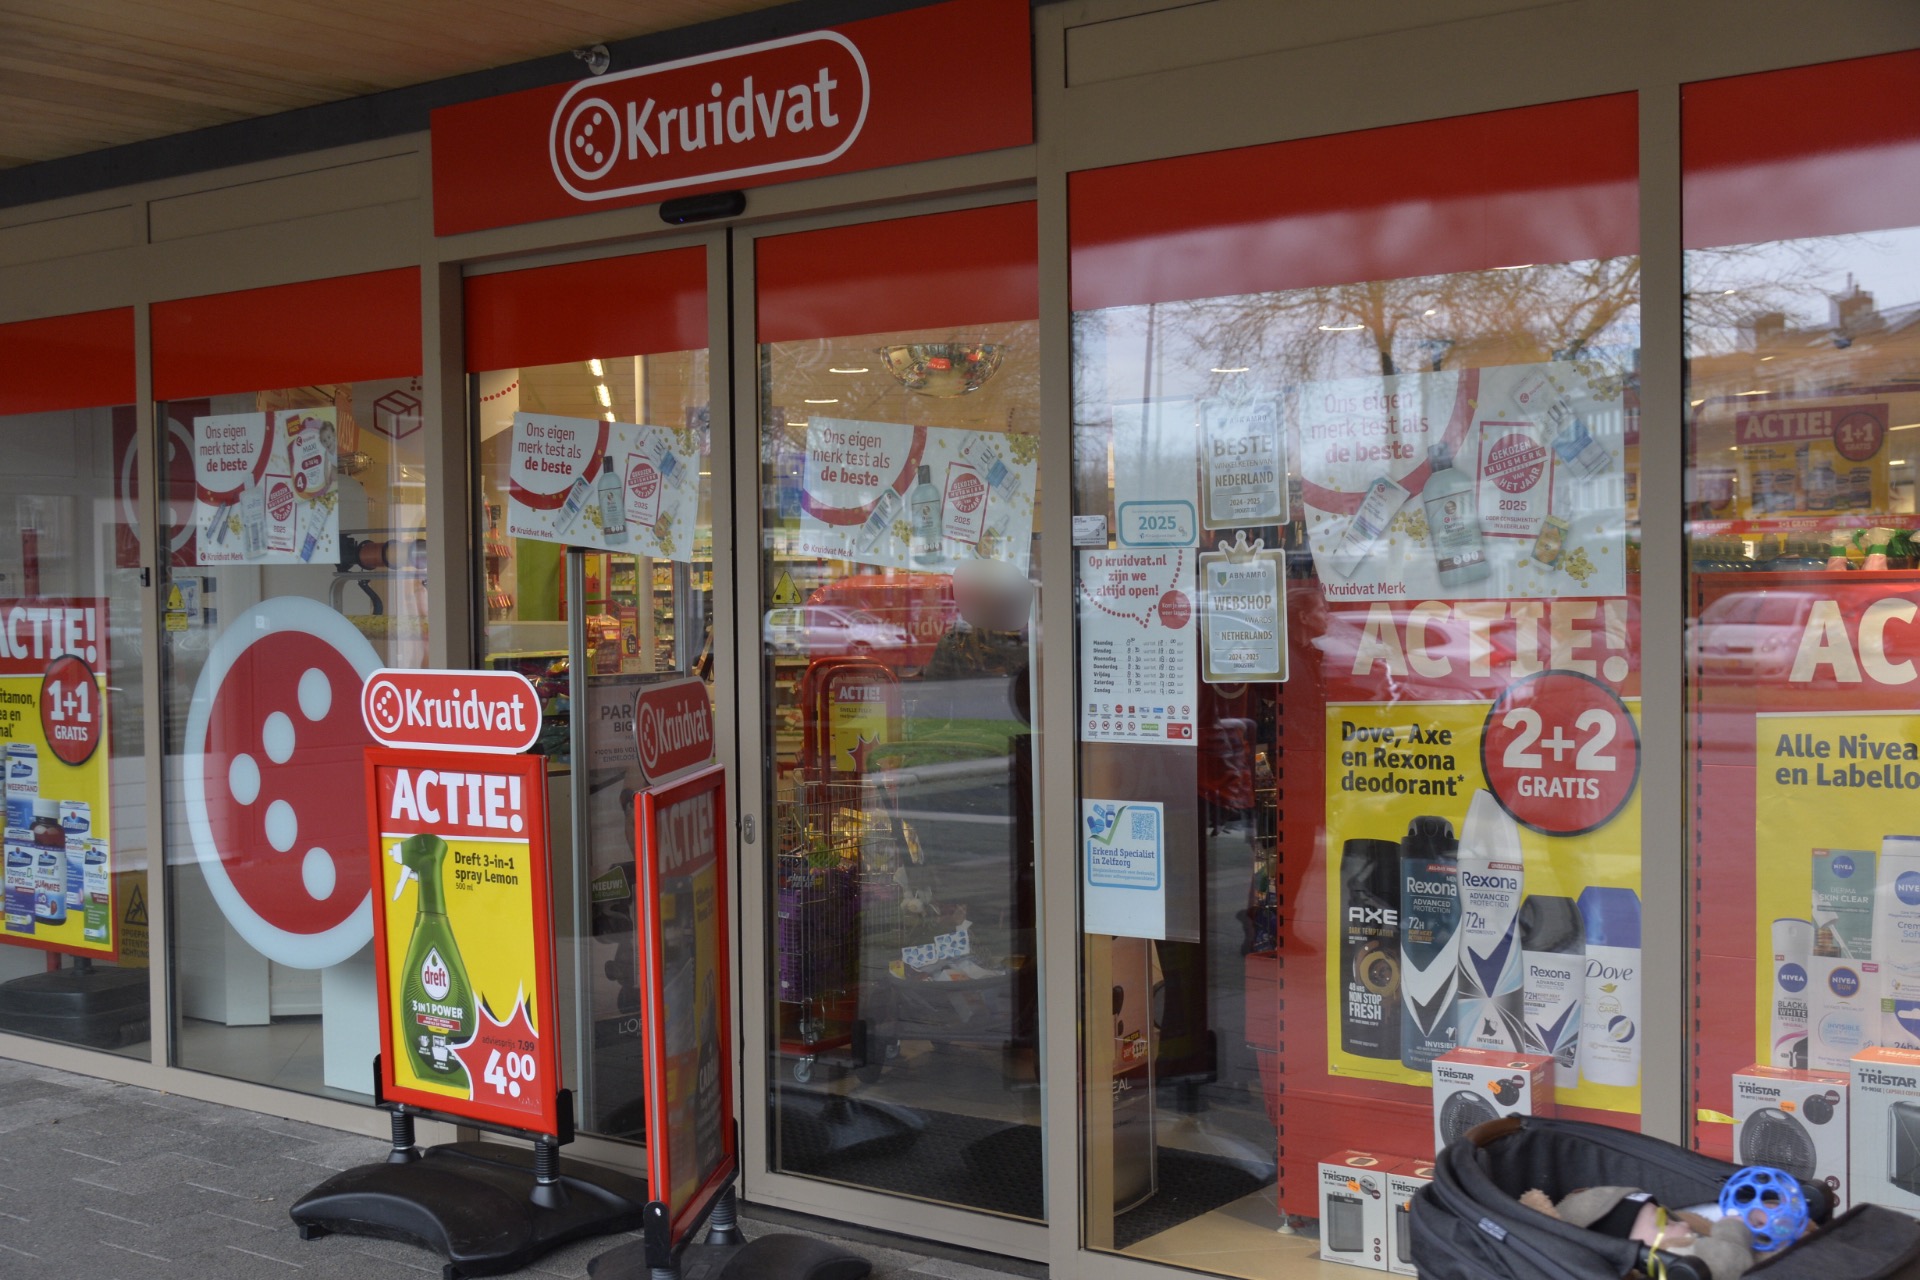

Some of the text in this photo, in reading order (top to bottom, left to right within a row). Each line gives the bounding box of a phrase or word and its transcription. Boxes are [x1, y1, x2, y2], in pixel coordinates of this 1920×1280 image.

[627, 67, 840, 160] Kruidvat
[1324, 389, 1413, 413] Ons eigen
[206, 424, 246, 440] Ons eigen
[526, 422, 575, 443] Ons eigen
[1311, 414, 1429, 439] merk test als
[1744, 410, 1833, 439] ACTIE!
[823, 428, 882, 450] Ons eigen
[1842, 423, 1874, 443] 1+1
[200, 442, 254, 456] merk test als
[518, 441, 582, 459] merk test als
[1213, 435, 1273, 457] BESTE
[1325, 438, 1415, 463] de beste
[1491, 441, 1532, 461] GEKOZEN
[206, 458, 248, 472] de beste
[524, 457, 572, 475] de beste
[813, 448, 890, 469] merk test als
[1488, 450, 1542, 474] HUISMERK
[820, 466, 879, 487] de beste
[1215, 471, 1274, 487] NEDERLAND
[1499, 467, 1540, 491] HET JAAR
[1512, 471, 1525, 480] VAN
[1498, 499, 1527, 511] 2025
[953, 515, 971, 526] 2025
[1138, 515, 1177, 530] 2025
[516, 526, 554, 538] Kruidvat Merk
[207, 552, 244, 561] Kruidvat Merk
[811, 543, 854, 558] Kruidvat Merk
[1088, 554, 1167, 569] Op kruidvat.nl
[1108, 569, 1147, 584] zijn we
[1096, 584, 1159, 599] altijd open!
[1328, 580, 1406, 596] Kruidvat Merk
[1213, 595, 1272, 611] WEBSHOP
[1244, 616, 1272, 624] AWARDS
[1221, 630, 1273, 641] NETHERLANDS
[1351, 599, 1629, 683] ACTIE!
[47, 680, 92, 722] 1+1
[839, 686, 880, 700] ACTIE!
[10, 710, 21, 721] en
[405, 688, 526, 732] Kruidvat
[54, 725, 88, 741] GRATIS
[655, 699, 710, 754] Kruidvat
[1341, 720, 1452, 746] Dove, Axe
[1502, 706, 1617, 772] 2+2
[1775, 733, 1919, 761] Alle Nivea
[1341, 747, 1455, 771] en Rexona
[1775, 763, 1920, 789] en Labello
[1516, 775, 1600, 799] GRATIS
[391, 769, 523, 833] ACTIE!
[656, 790, 714, 874] ACTIE!
[454, 851, 515, 869] Dreft 3-in-1
[1092, 847, 1155, 859] Erkend Specialist
[1092, 856, 1131, 869] in Zelfzorg
[455, 869, 518, 886] spray Lemon
[592, 879, 623, 892] NIEUW!
[1462, 871, 1518, 890] Rexona
[455, 882, 473, 891] 500 ml
[1406, 876, 1457, 897] Rexona
[1830, 886, 1856, 894] DERMA
[1412, 898, 1451, 907] ADVANCED
[1469, 893, 1510, 902] ADVANCED
[1469, 899, 1510, 908] PROTECTION
[1818, 894, 1869, 903] SKIN CLEAR
[1348, 906, 1398, 926] AXE
[1413, 905, 1451, 914] PROTECTION
[1408, 916, 1425, 930] 72H
[1465, 911, 1486, 929] 72H
[424, 966, 447, 987] dreft
[1530, 965, 1571, 980] Rexona
[1585, 958, 1633, 981] Dove
[1781, 974, 1805, 982] NIVEA
[1831, 976, 1857, 985] NIVEA
[1348, 991, 1382, 1006] NON STOP
[1524, 991, 1537, 1000] 72H
[412, 1000, 463, 1019] 3 IN POWER
[1349, 1002, 1382, 1020] FRESH
[1598, 1006, 1620, 1014] CARE
[1779, 1009, 1807, 1018] WHITE
[1827, 1023, 1860, 1031] INVISIBLE
[481, 1035, 535, 1052] adviesprijs 7.99
[1476, 1037, 1504, 1045] INVISIBLE
[1437, 1068, 1474, 1081] TRISTAR
[1858, 1069, 1917, 1088] TRISTAR
[1738, 1083, 1781, 1096] TRISTAR
